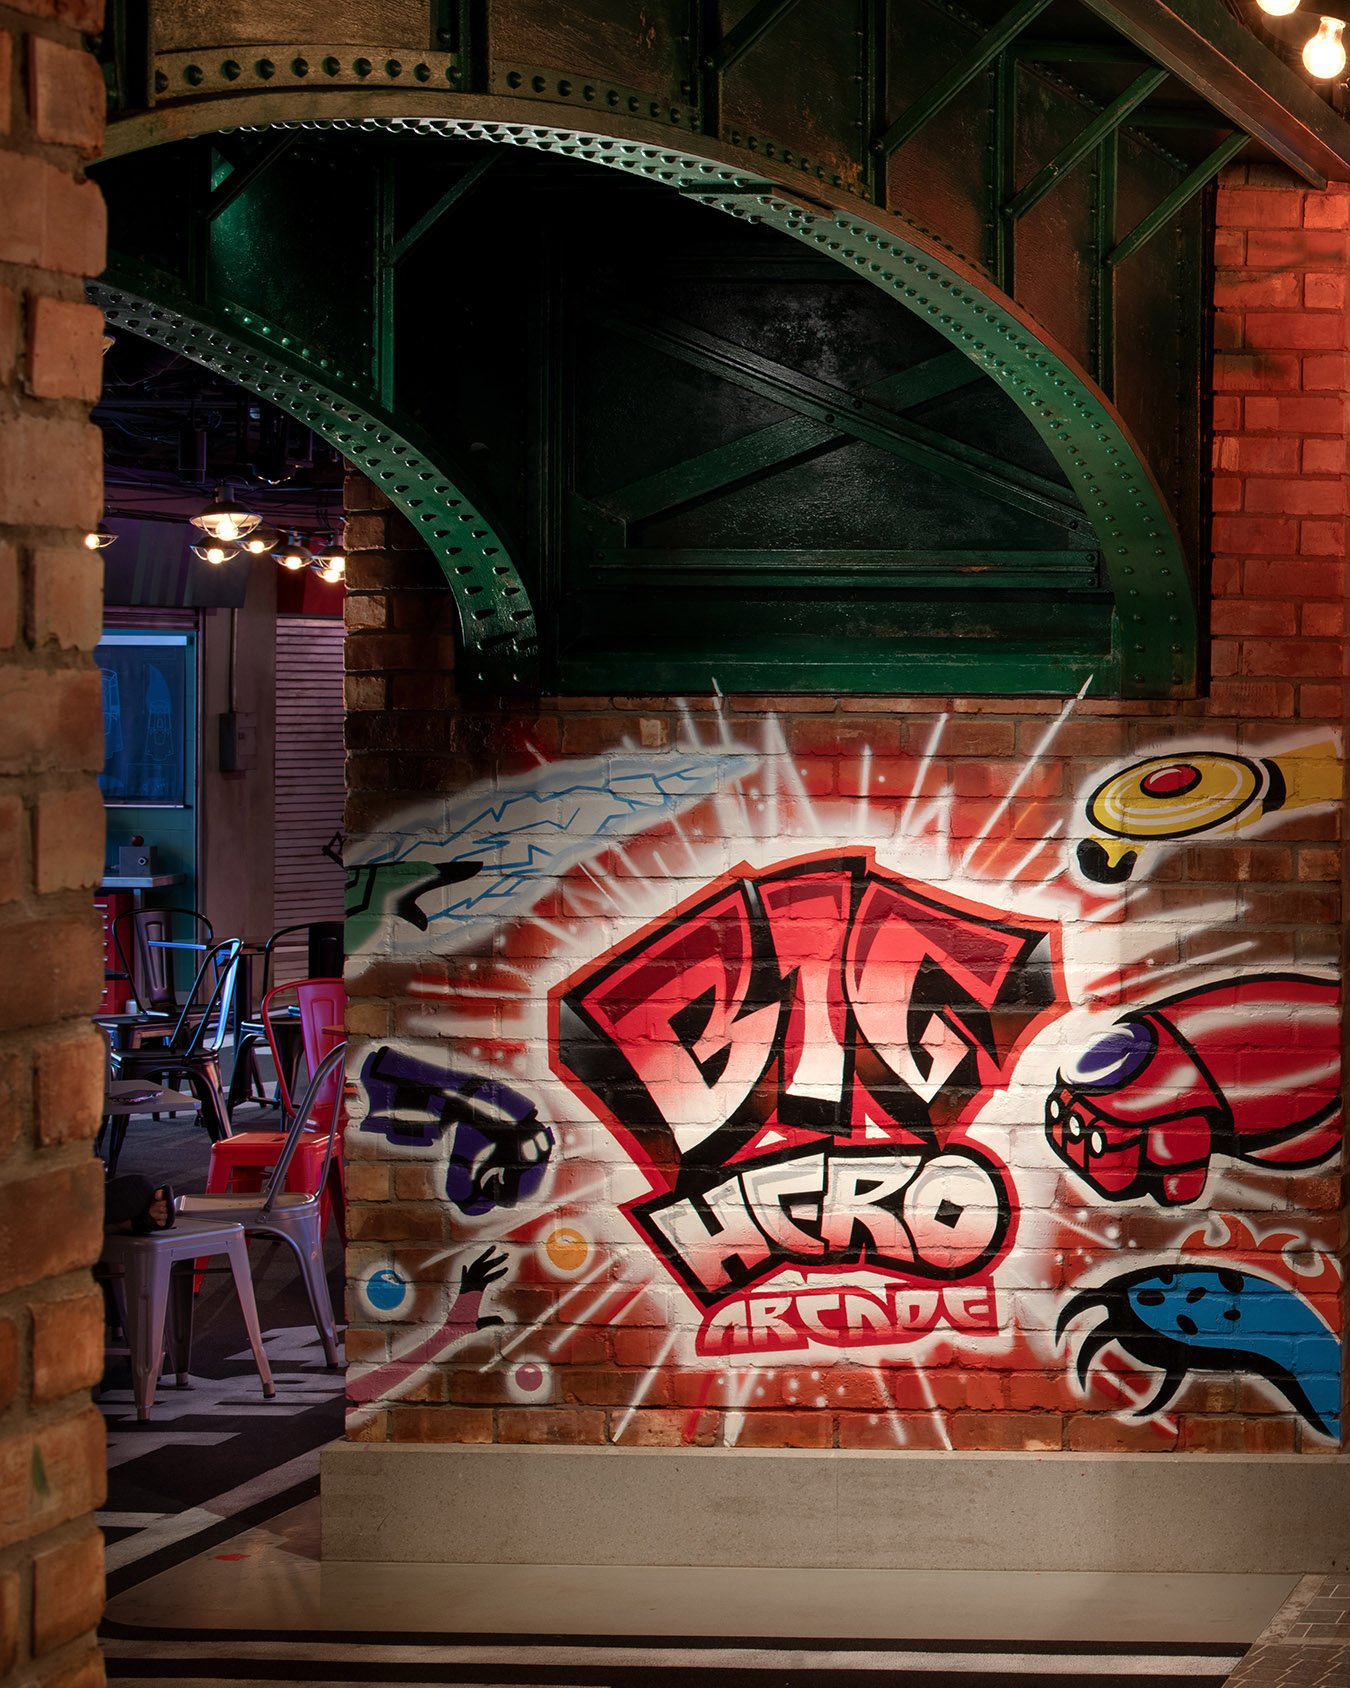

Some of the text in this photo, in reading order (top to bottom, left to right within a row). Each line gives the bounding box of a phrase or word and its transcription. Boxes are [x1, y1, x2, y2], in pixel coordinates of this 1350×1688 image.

[572, 862, 1042, 1157] BIG
[648, 1152, 999, 1290] HERO
[702, 1286, 995, 1351] ARCADE
